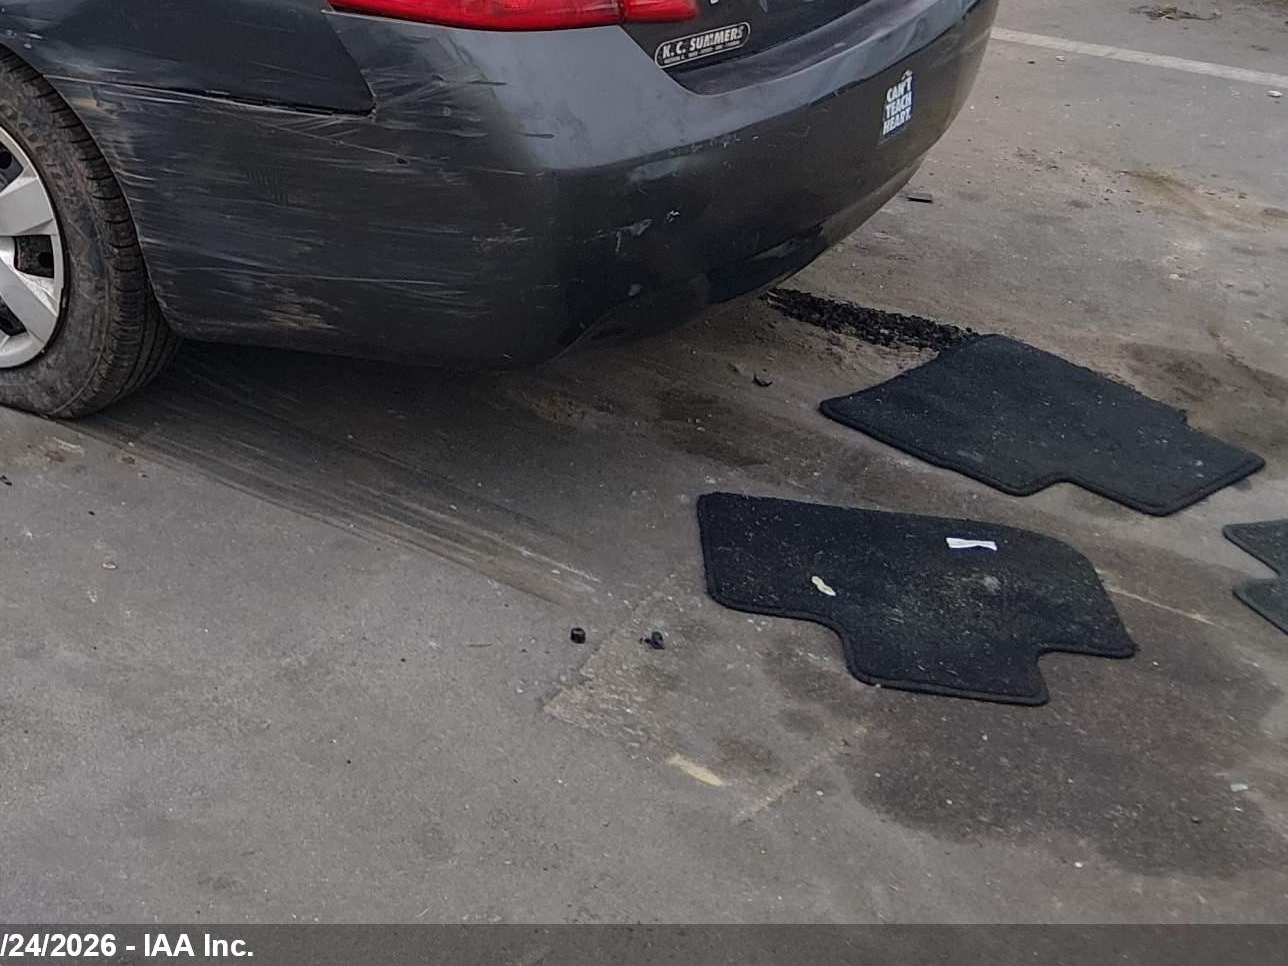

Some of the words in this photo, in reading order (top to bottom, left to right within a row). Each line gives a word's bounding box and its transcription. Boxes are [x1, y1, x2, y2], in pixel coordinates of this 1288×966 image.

[689, 25, 745, 52] SUMMERS
[886, 76, 913, 103] CAN'T
[886, 91, 913, 118] TEACH
